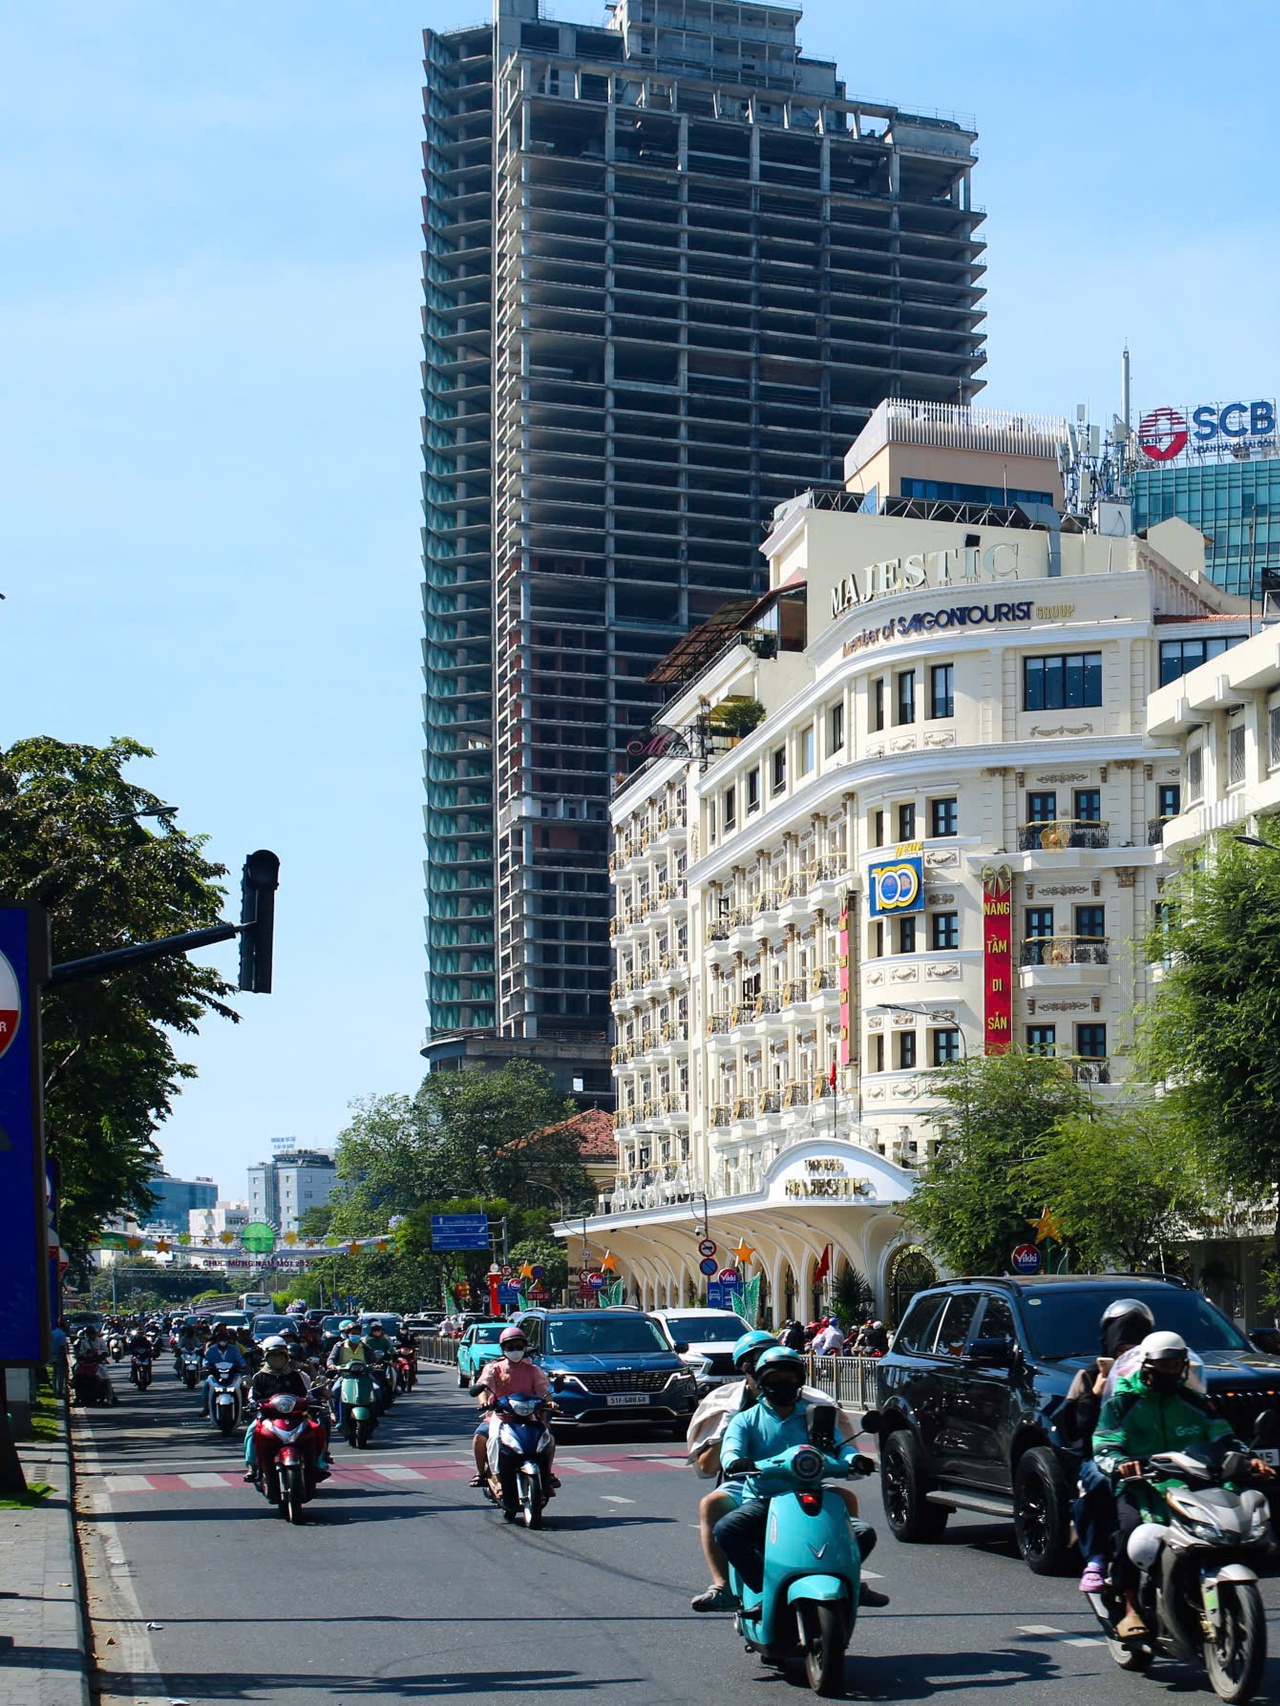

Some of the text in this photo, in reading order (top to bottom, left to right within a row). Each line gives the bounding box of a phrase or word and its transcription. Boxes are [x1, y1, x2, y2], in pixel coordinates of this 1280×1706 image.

[1193, 401, 1275, 440] SCB
[830, 543, 1019, 620] MAJESTIC
[882, 618, 896, 639] of
[897, 601, 1034, 635] SAIGONTOURIST
[1036, 602, 1074, 619] GROUP
[870, 864, 919, 911] 100
[984, 899, 1009, 1029] NÂNG TẦM DI SẢN
[785, 1177, 872, 1197] MAJESTIC
[1015, 1250, 1037, 1262] Vikki
